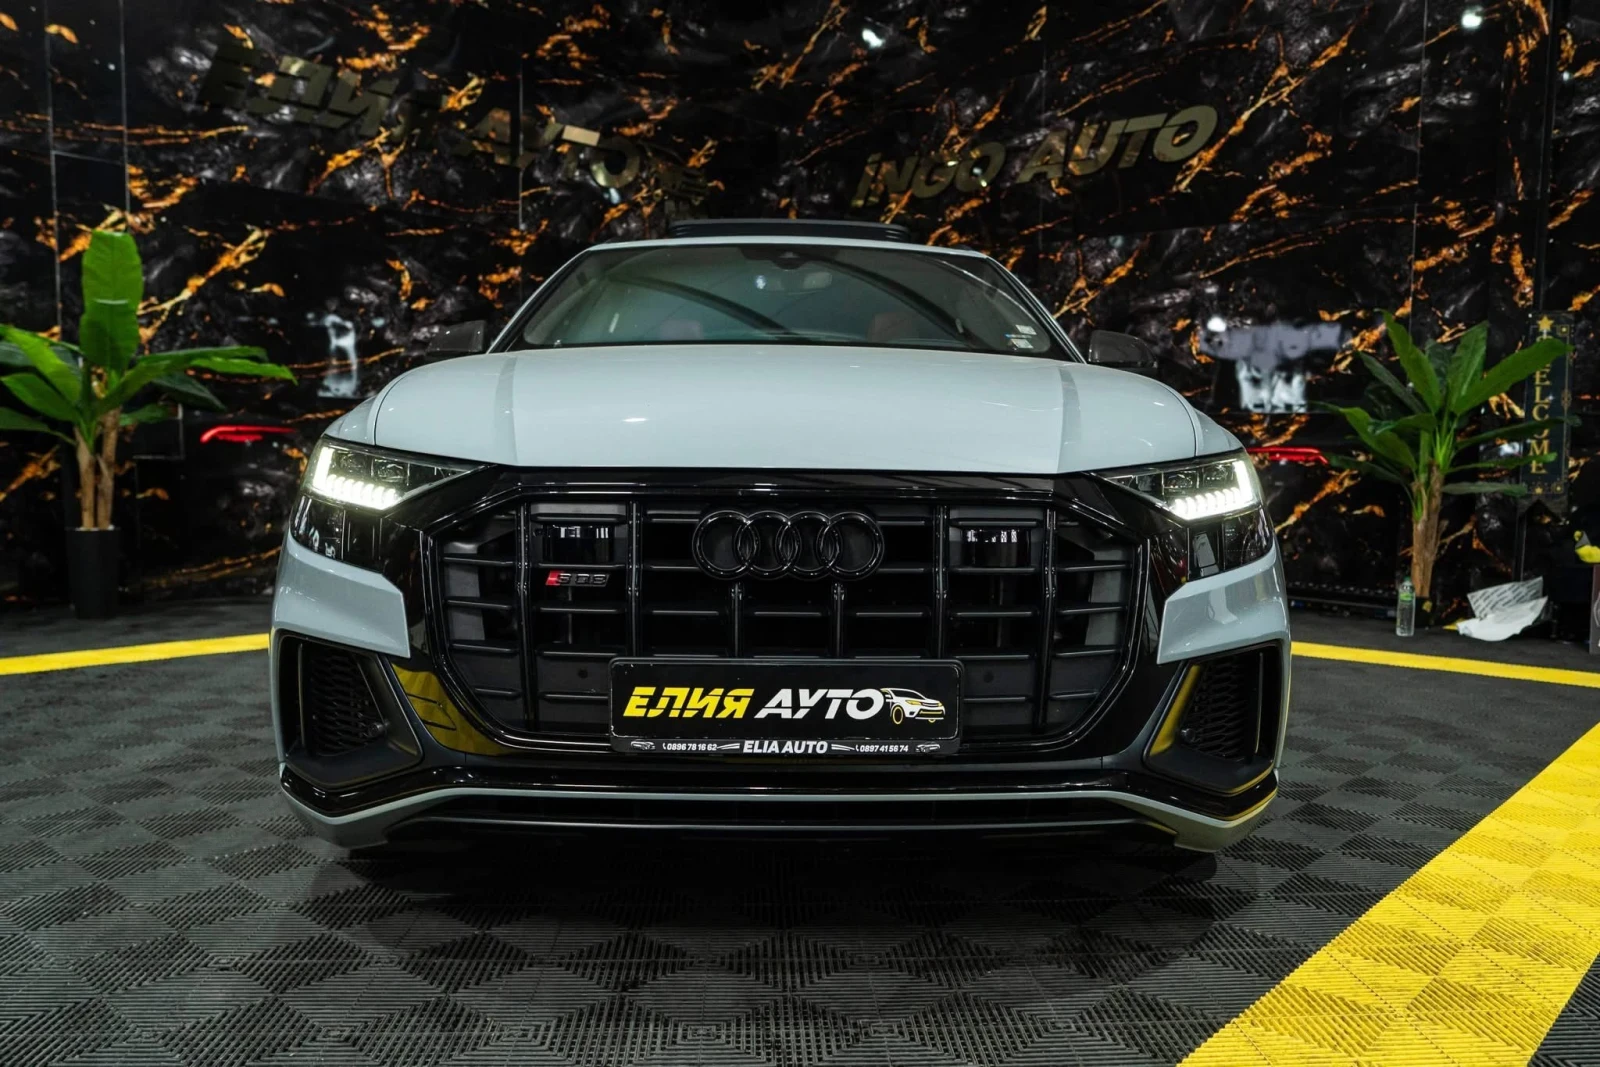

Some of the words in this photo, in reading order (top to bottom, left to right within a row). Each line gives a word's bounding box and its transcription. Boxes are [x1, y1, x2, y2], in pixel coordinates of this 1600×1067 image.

[1014, 105, 1219, 184] AUTO
[1529, 356, 1551, 475] ELCME
[623, 686, 754, 719] ЕЛИЯ
[754, 688, 884, 720] АУТО
[667, 742, 686, 751] 0896
[687, 743, 697, 751] 78
[698, 743, 706, 751] 16
[708, 743, 717, 751] 62
[743, 740, 779, 753] ELIA
[781, 740, 828, 754] AUTO
[859, 744, 879, 753] 0897
[879, 744, 889, 753] 41
[889, 744, 898, 753] 56
[899, 744, 909, 753] 74
